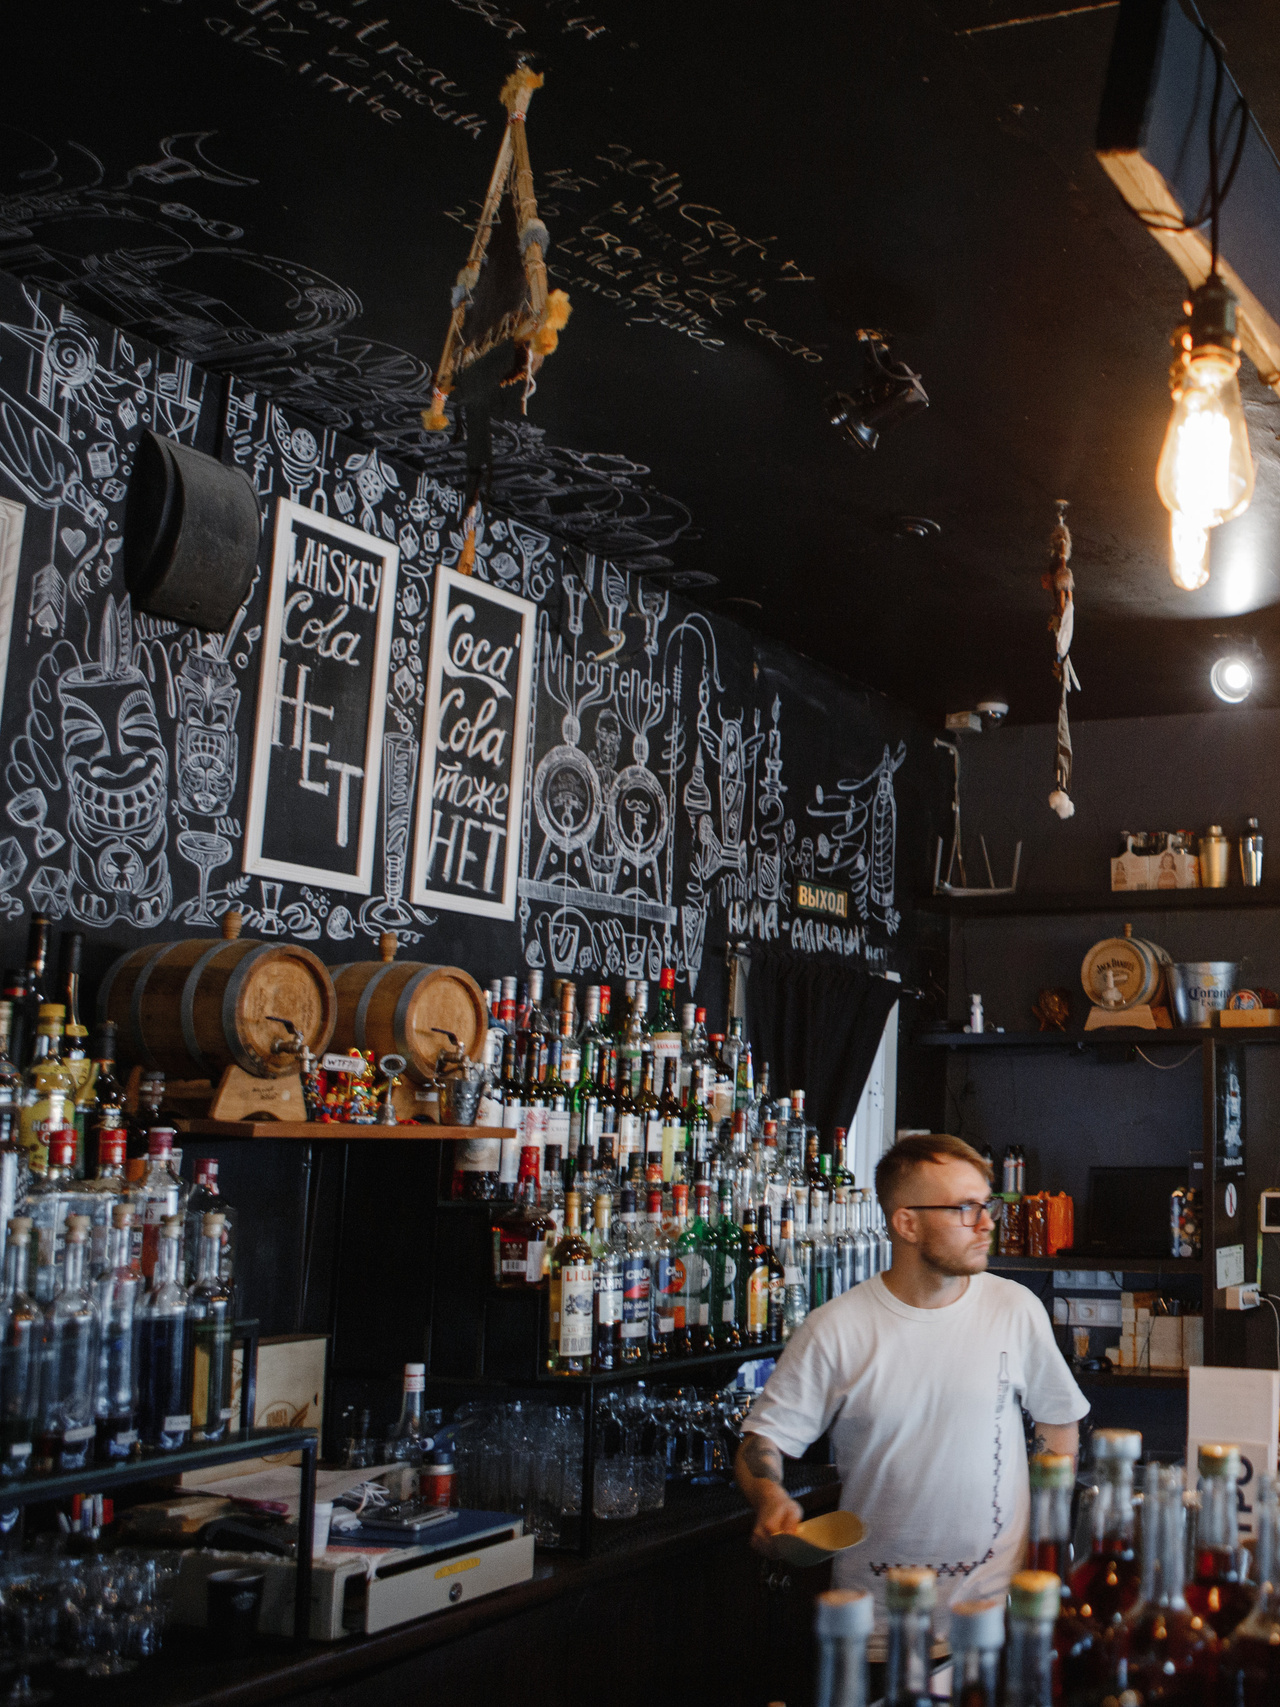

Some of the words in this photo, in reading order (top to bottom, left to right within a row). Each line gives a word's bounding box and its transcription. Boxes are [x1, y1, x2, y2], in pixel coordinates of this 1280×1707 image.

[299, 0, 468, 97] ointreau
[280, 590, 361, 667] Cola
[270, 657, 365, 848] НЕТ
[436, 687, 509, 767] Cola
[426, 810, 508, 895] НЕТ
[799, 884, 845, 917] ВЫХОД
